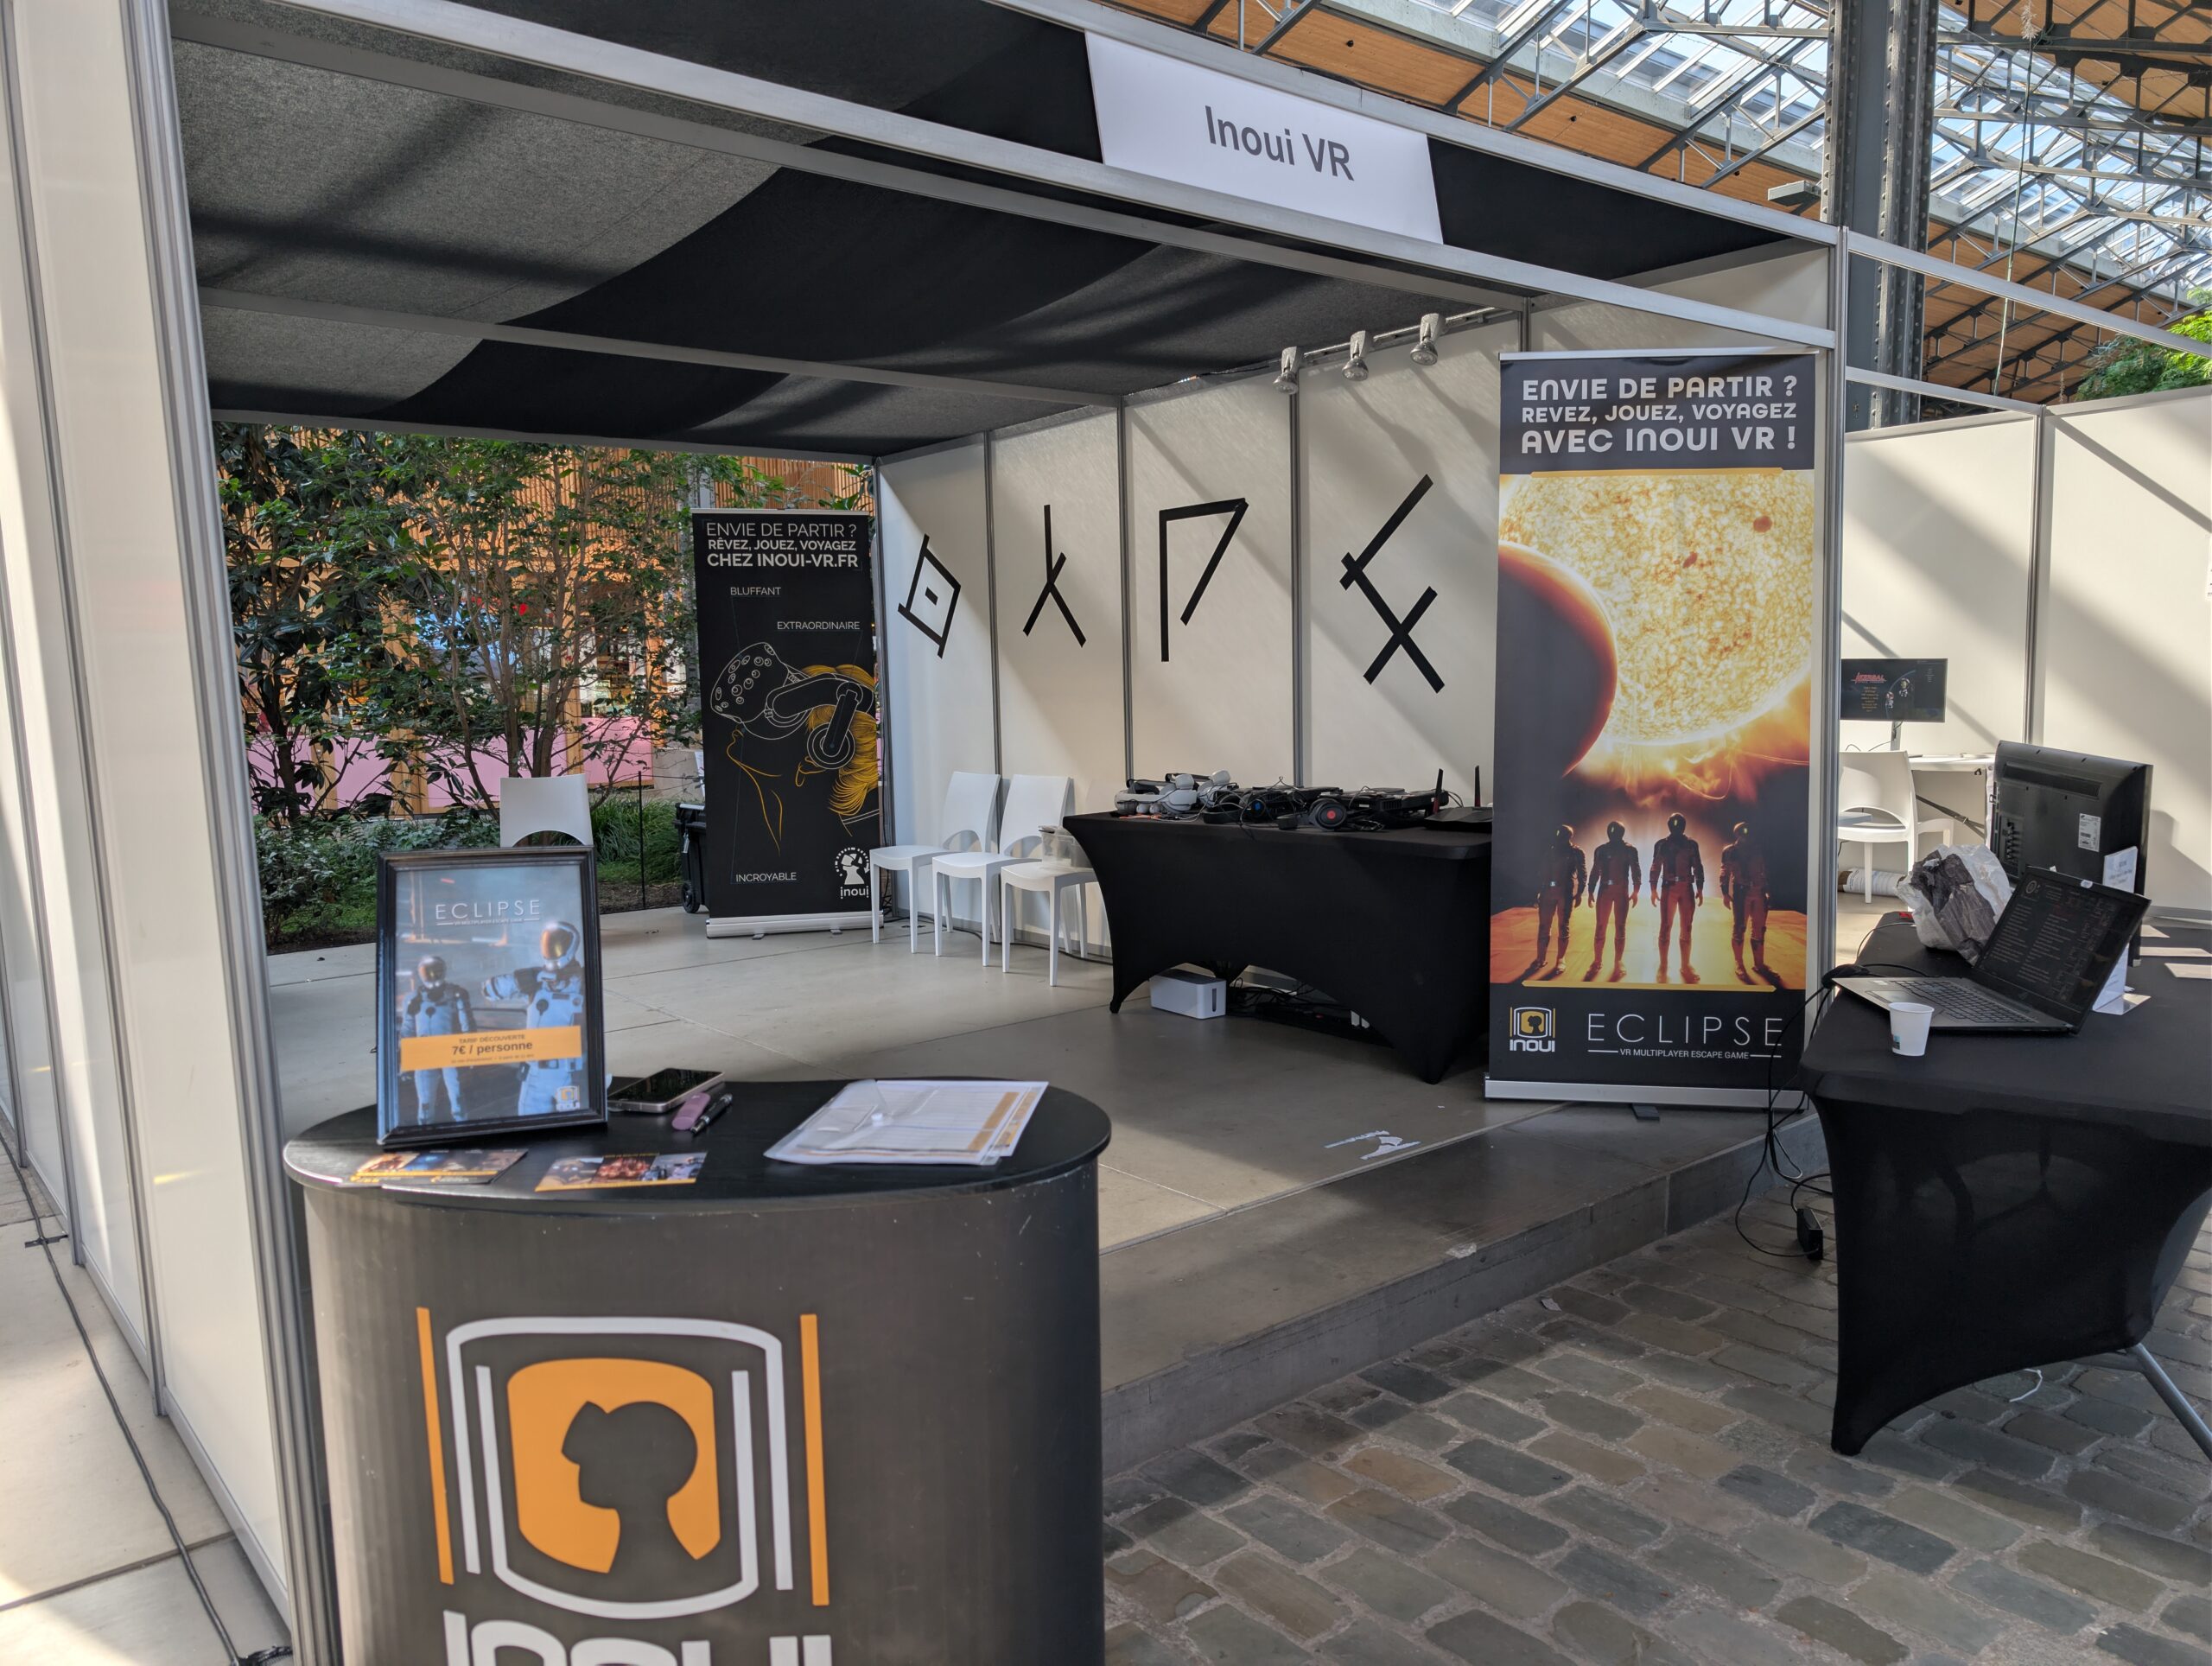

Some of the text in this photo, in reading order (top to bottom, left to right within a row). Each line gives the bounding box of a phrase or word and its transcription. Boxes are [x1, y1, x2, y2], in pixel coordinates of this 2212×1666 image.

[1205, 105, 1355, 181] Inoui VR
[1522, 375, 1797, 401] ENVIE DE PARTIR ?
[1522, 403, 1796, 425] REVEZ, JOUEZ, VOYAGEZ
[1522, 426, 1796, 454] AVEC INOUI VR !
[707, 523, 857, 537] ENVIE DE PARTIR ?
[709, 537, 856, 552] RÊVEZ, JOUEZ, VOYAGEZ
[707, 553, 859, 568] CHEZ INOUI-VR.FR
[730, 587, 781, 595] BLUFFANT
[777, 621, 861, 630] EXTRAORDINAIRE
[735, 872, 798, 882] INCROYABLE
[840, 886, 869, 900] inoui
[435, 900, 540, 919] ECLIPSE
[1588, 1014, 1783, 1046] ECLIPSE
[452, 1045, 466, 1055] 7€
[477, 1041, 533, 1055] personne
[1510, 1039, 1555, 1052] INOUI
[1633, 1049, 1689, 1058] MULTIPLAYER
